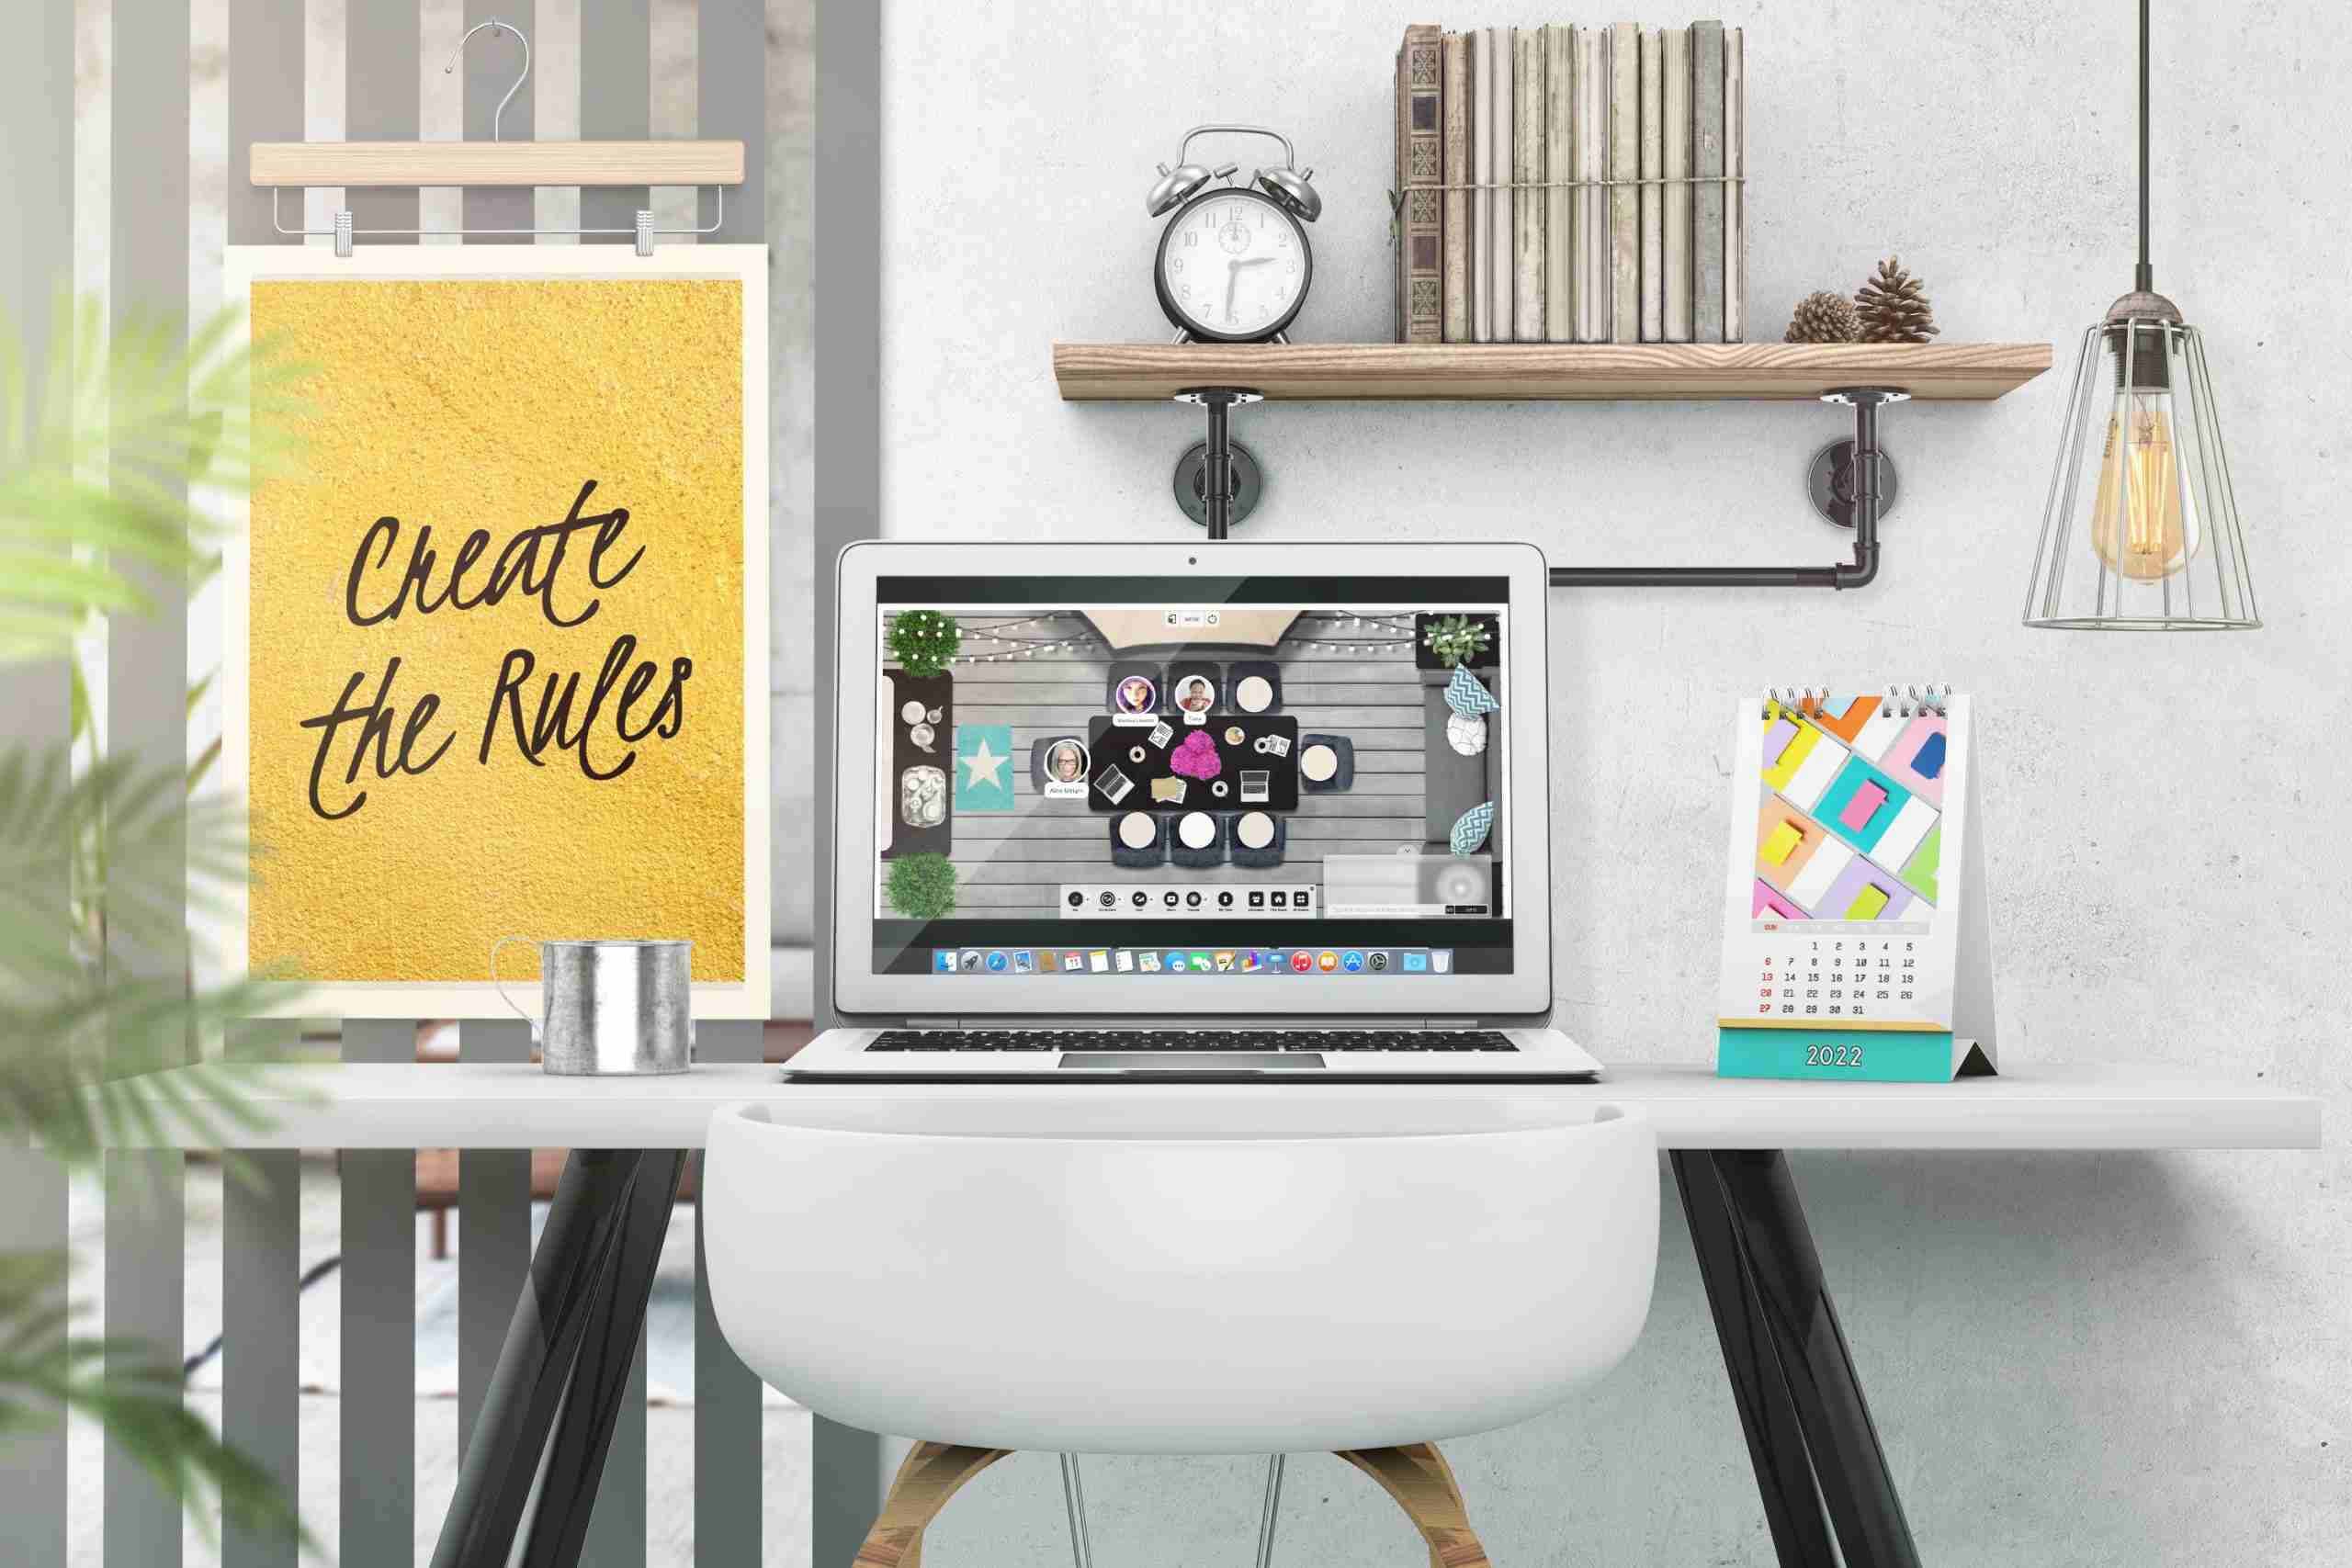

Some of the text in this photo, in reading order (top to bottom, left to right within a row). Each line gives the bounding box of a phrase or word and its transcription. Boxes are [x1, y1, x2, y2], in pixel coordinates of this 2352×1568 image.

[1205, 213, 1216, 228] 11
[1229, 206, 1243, 221] 12
[1183, 231, 1198, 247] 10
[1279, 232, 1287, 247] 2
[1174, 258, 1183, 273] 9
[1203, 303, 1213, 318] 7
[346, 479, 646, 627] Create
[300, 635, 692, 819] the Rules
[1813, 942, 1817, 950] 1
[1836, 942, 1842, 951] 2
[1860, 942, 1865, 951] 3
[1906, 942, 1913, 951] 5
[1765, 957, 1914, 967] 6 7 8 9 10 11 12
[1762, 973, 1913, 983] 13 14 15 16 17 18 19
[1760, 988, 1771, 998] 20
[1783, 989, 1793, 998] 21
[1806, 989, 1818, 998] 22
[1830, 990, 1842, 998] 23
[1852, 990, 1865, 998] 24
[1901, 991, 1913, 999] 26
[1759, 1004, 1865, 1014] 27 28 29 30 31
[1806, 1044, 1862, 1066] 2022
